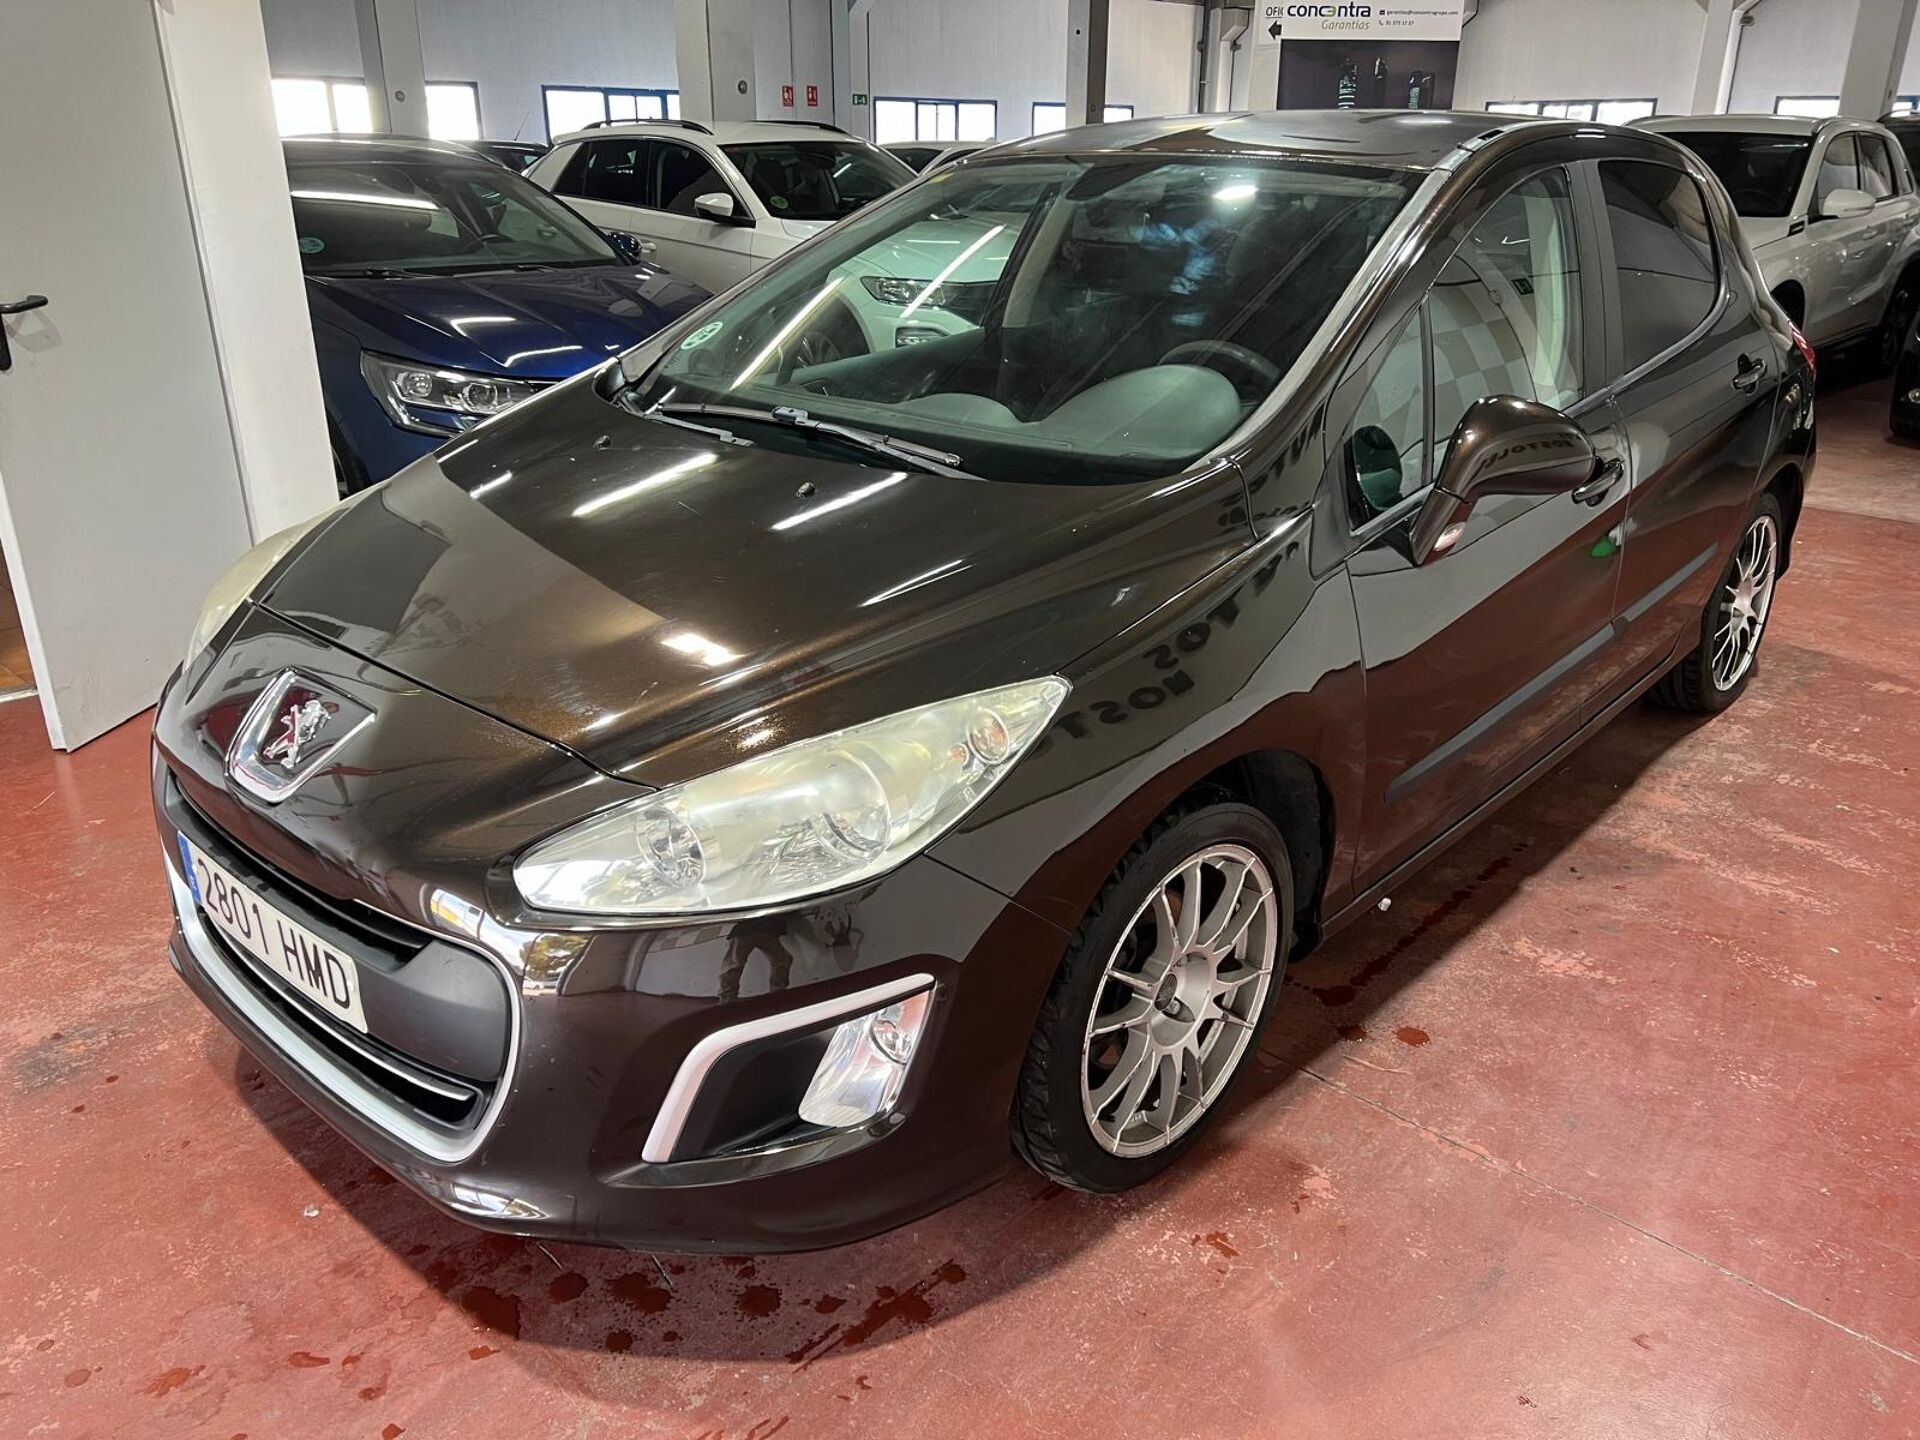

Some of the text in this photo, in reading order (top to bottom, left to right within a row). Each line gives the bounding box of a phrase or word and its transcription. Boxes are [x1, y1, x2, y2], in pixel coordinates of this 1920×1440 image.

[1287, 1, 1371, 17] concentra
[198, 858, 350, 1009] 2801 HMD
